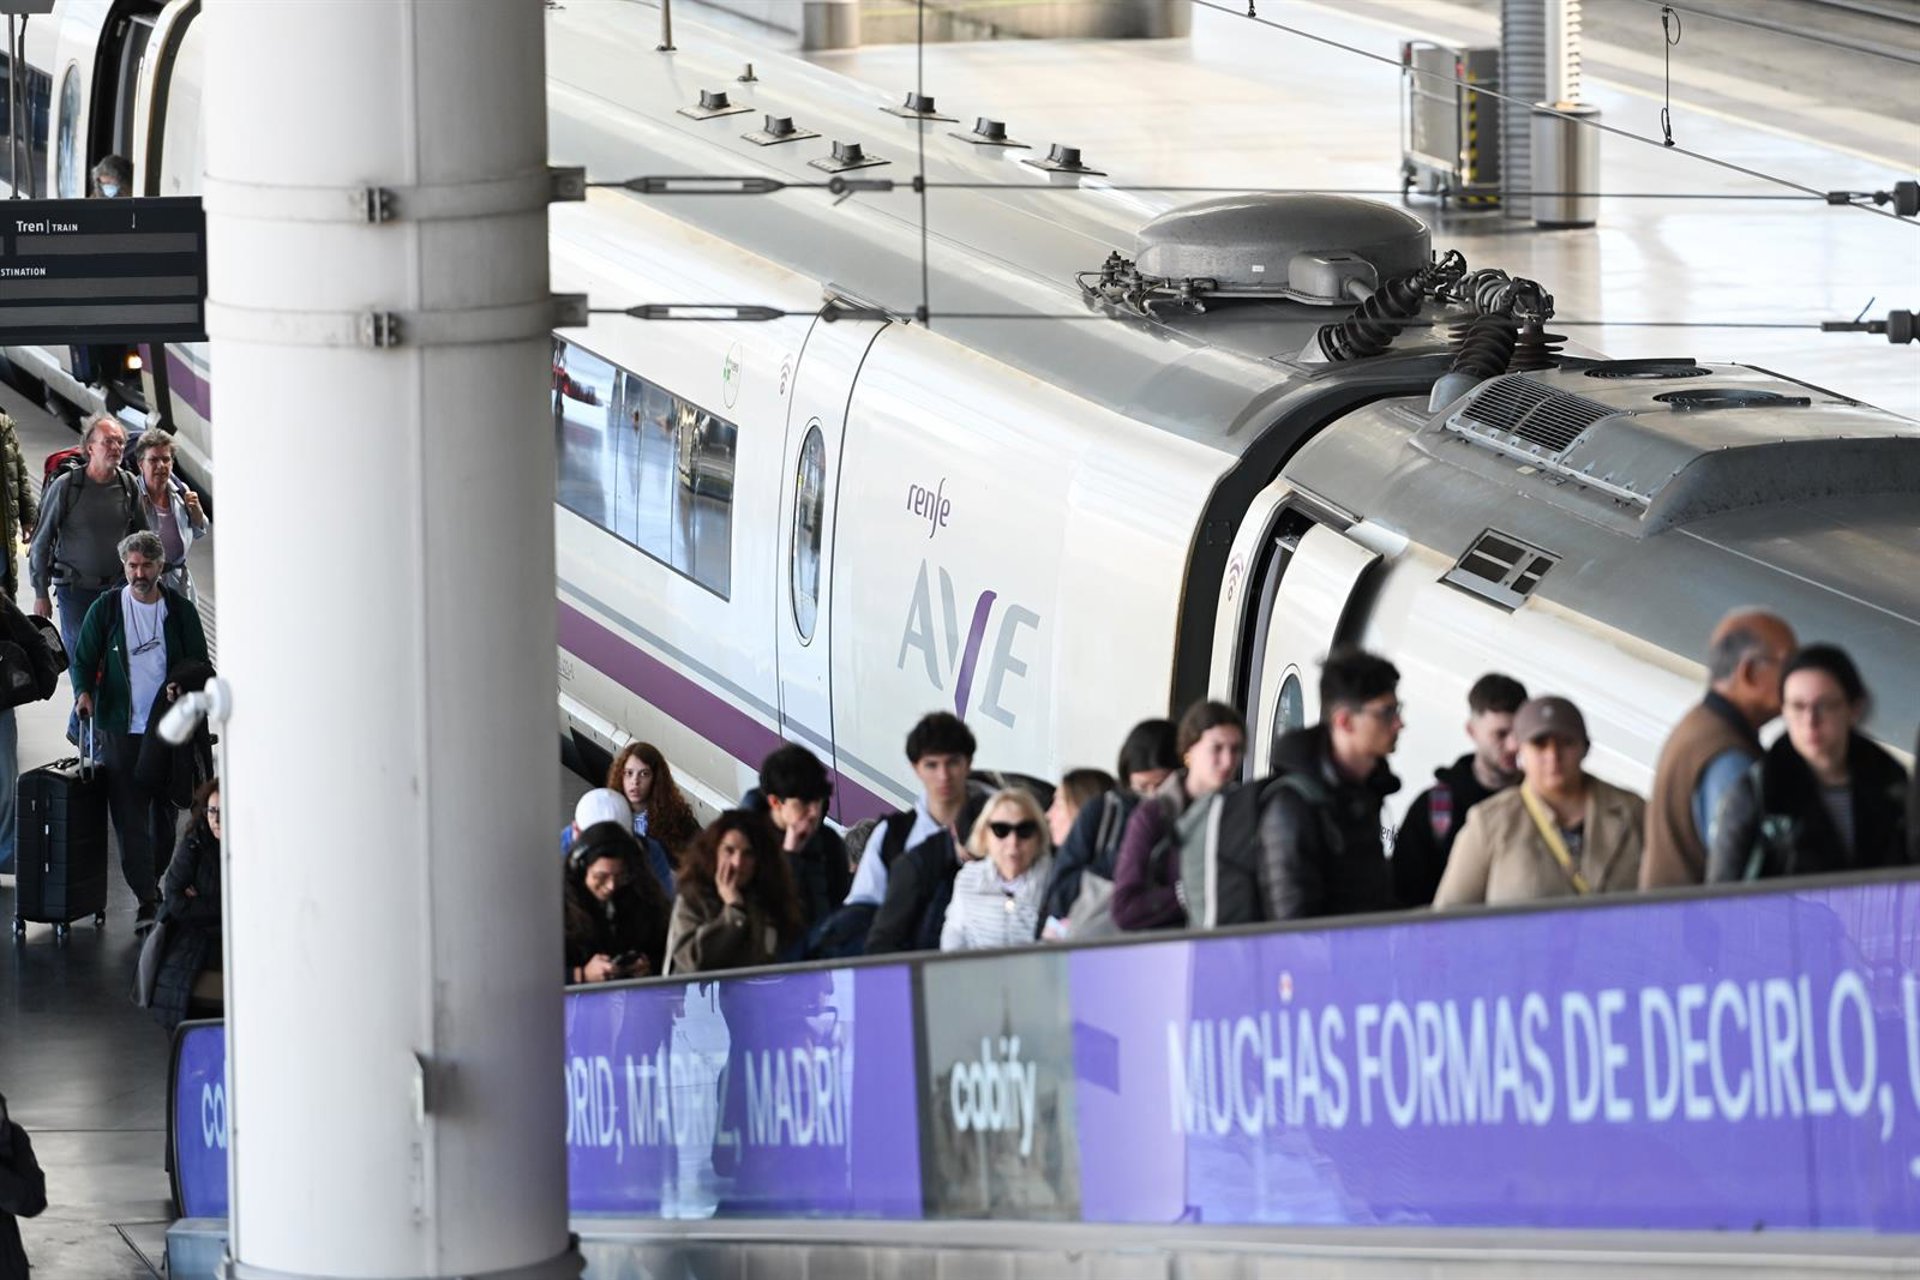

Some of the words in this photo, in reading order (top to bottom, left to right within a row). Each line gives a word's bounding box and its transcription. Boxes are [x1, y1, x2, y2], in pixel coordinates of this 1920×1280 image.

[16, 220, 44, 232] Tren
[52, 223, 78, 232] TRAIN
[0, 268, 46, 277] STINATION
[906, 477, 951, 539] renfe
[897, 557, 1041, 730] AVE
[1166, 1002, 1350, 1138] MUCHAS
[1355, 991, 1555, 1128] FORMAS
[1561, 988, 1634, 1123] DE
[1640, 969, 1895, 1143] DECIRLO,
